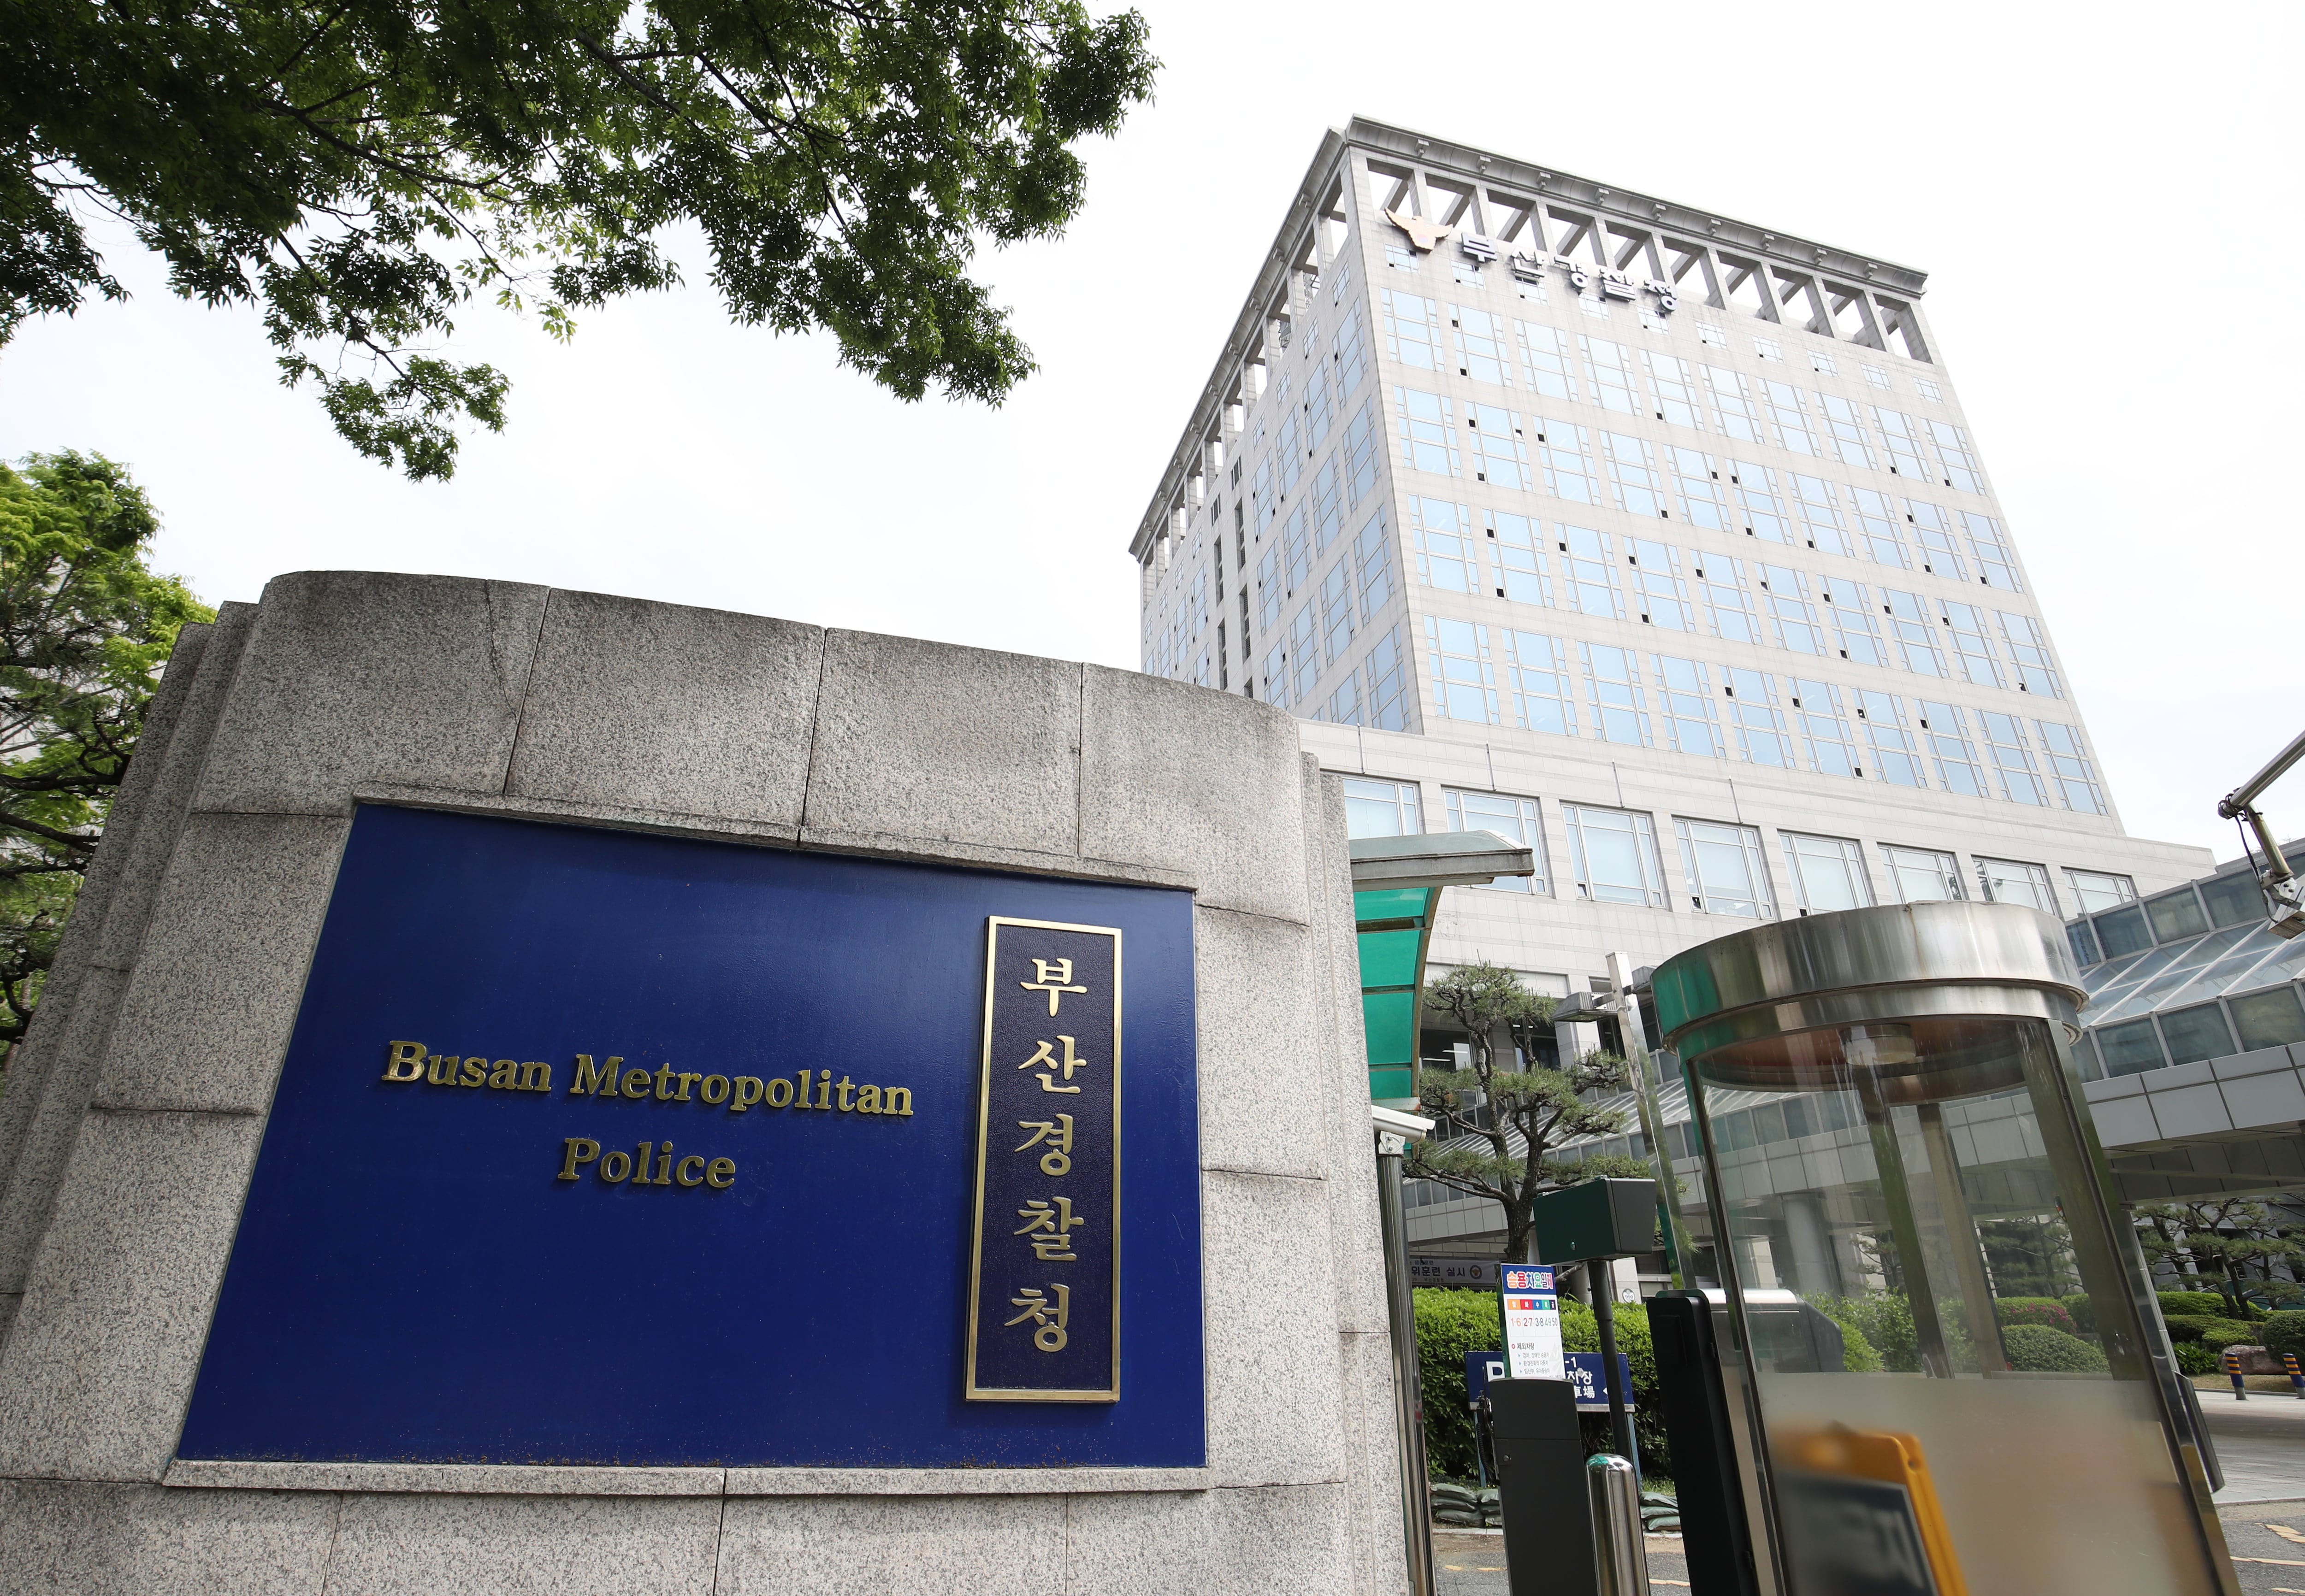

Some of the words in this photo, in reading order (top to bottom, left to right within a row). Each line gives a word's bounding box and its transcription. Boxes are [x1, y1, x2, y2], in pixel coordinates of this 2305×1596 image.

[1461, 232, 1679, 312] 부산경찰청
[381, 1040, 551, 1091] Busan
[570, 1054, 914, 1116] Metropolitan
[558, 1137, 736, 1188] Police
[1004, 958, 1087, 1353] 부산경찰청
[1411, 1266, 1441, 1276] 위훈련
[1446, 1266, 1466, 1277] 실시
[1507, 1271, 1554, 1290] 승용차요일제
